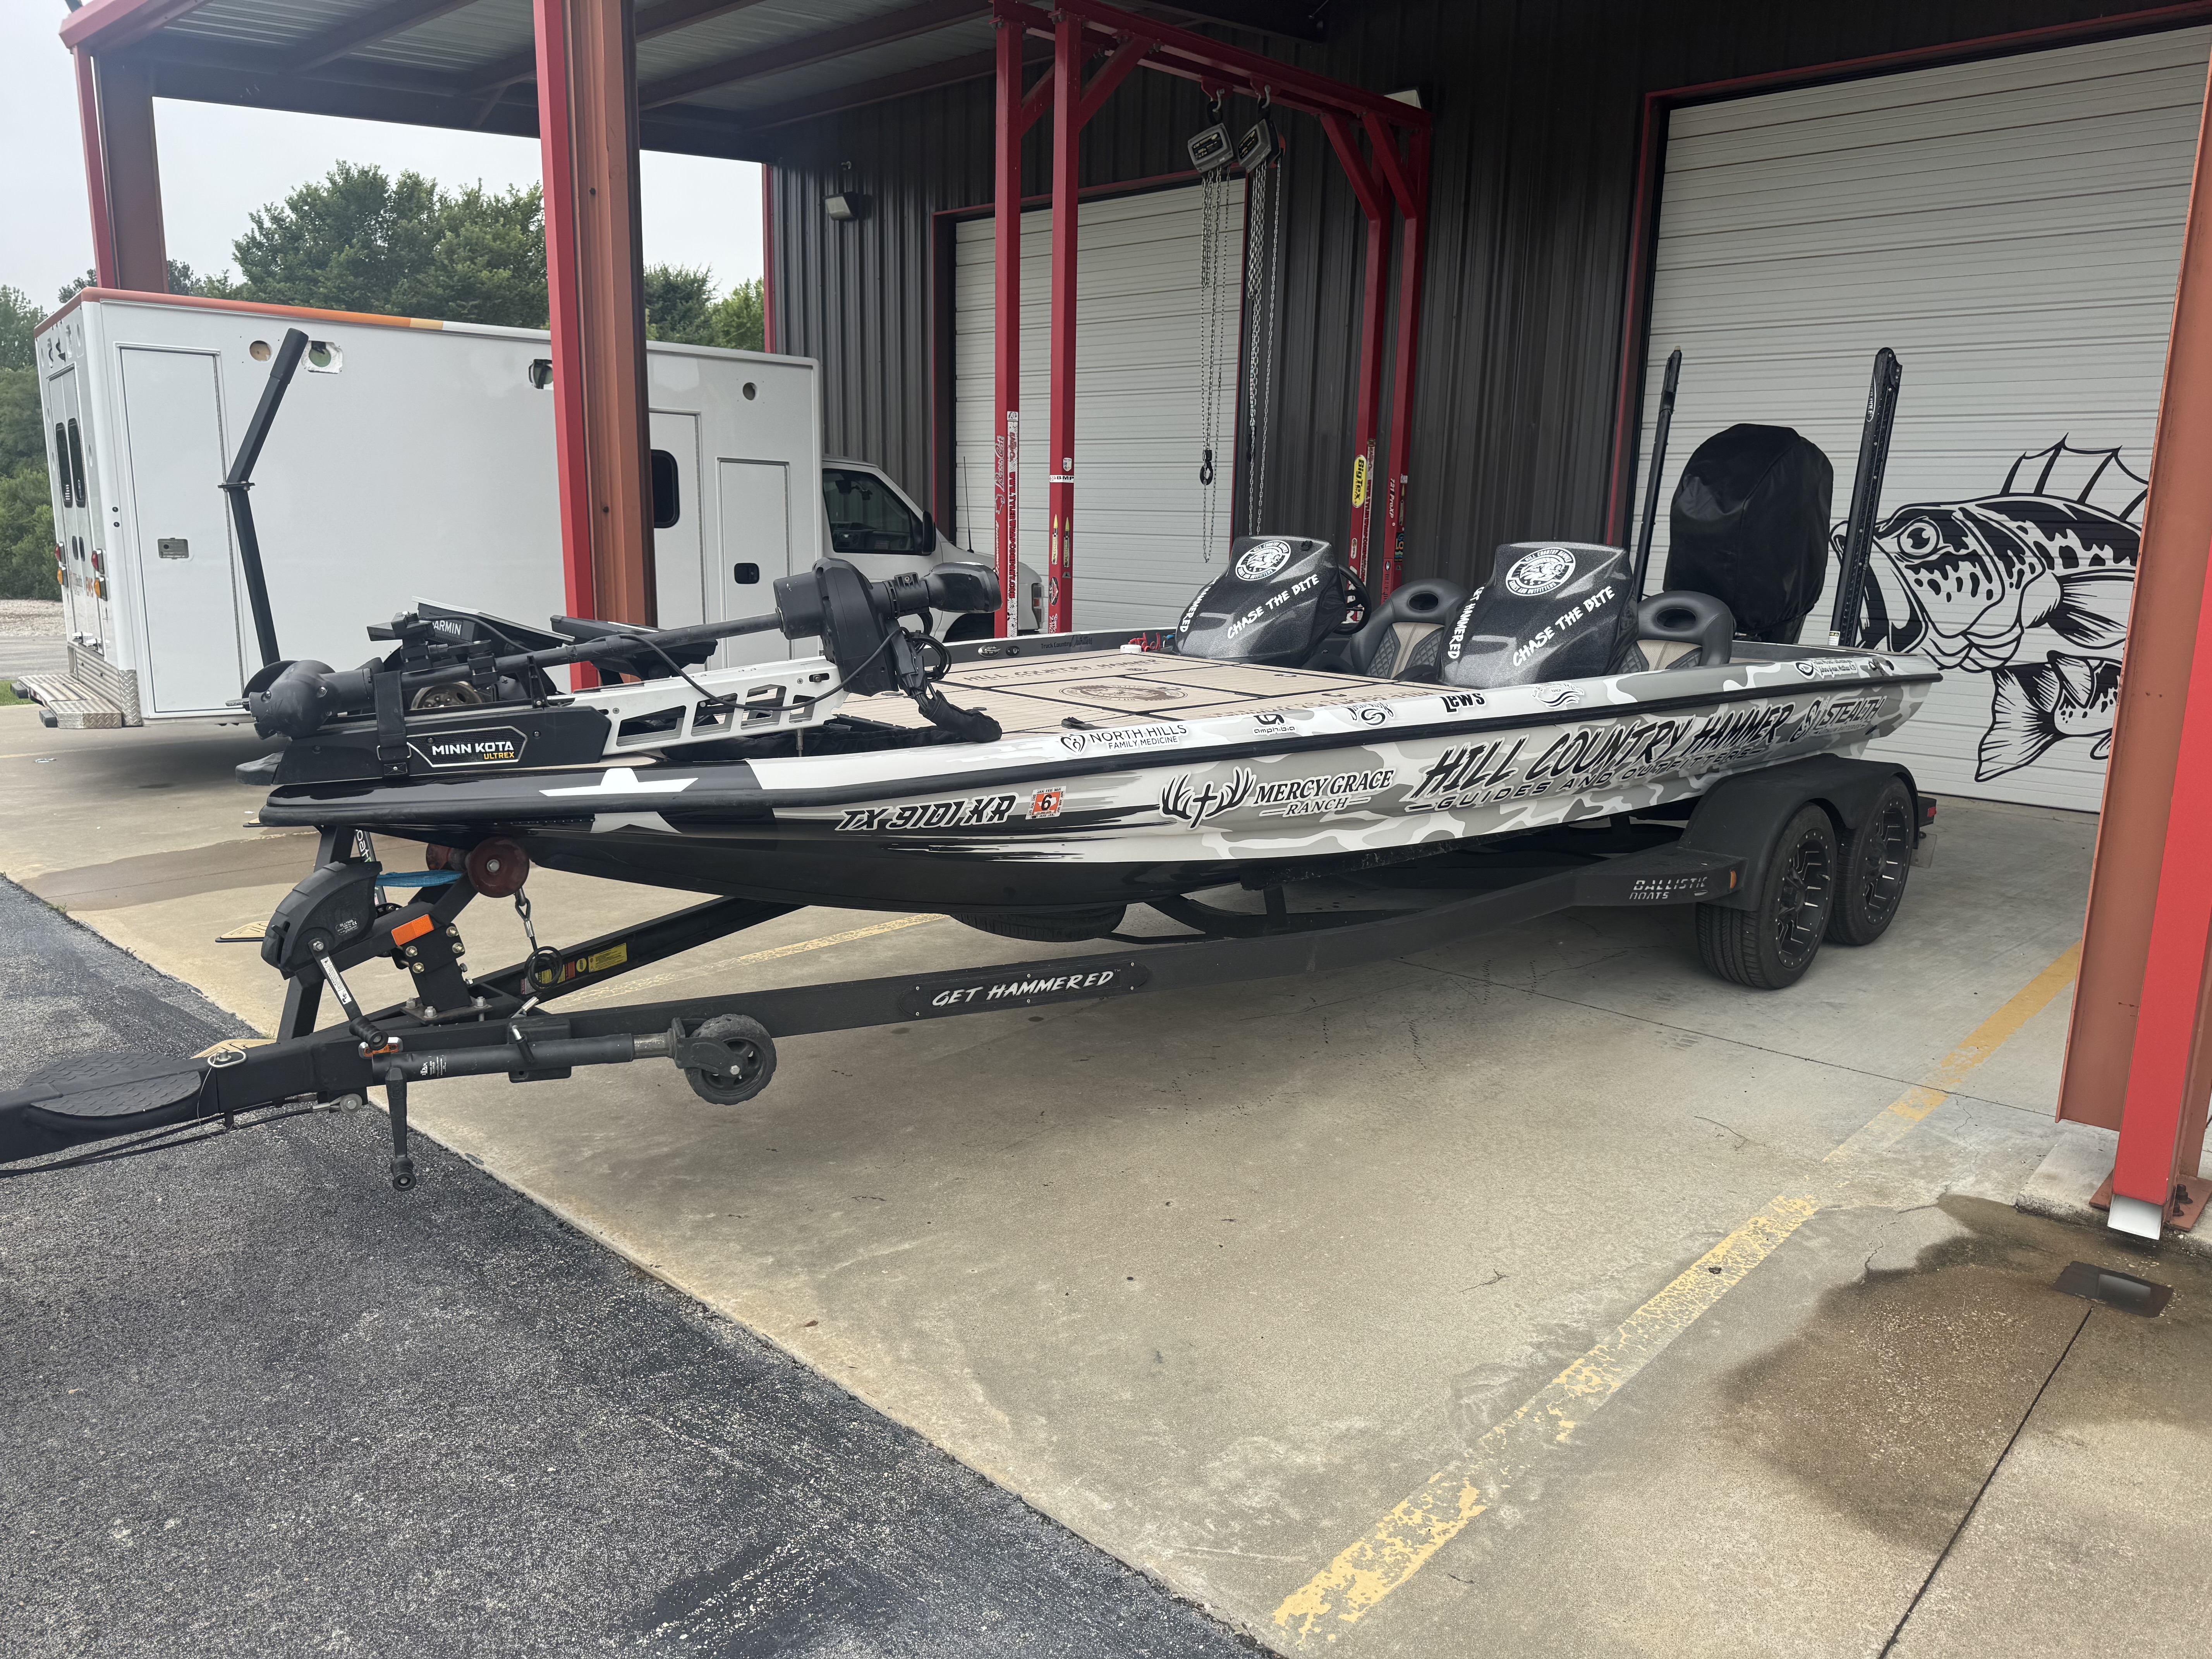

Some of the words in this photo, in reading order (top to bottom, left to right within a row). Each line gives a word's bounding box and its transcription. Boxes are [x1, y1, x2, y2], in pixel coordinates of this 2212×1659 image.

[1470, 586, 1485, 601] GET
[1180, 586, 1211, 633] HAMMERED
[1227, 606, 1264, 639] CHASE
[1265, 590, 1290, 610] THE
[1291, 574, 1320, 596] BITE
[432, 620, 462, 635] ARMIN
[1447, 603, 1476, 659] HAMMERED
[1512, 626, 1555, 667] CHASE
[1554, 606, 1583, 630] THE
[1582, 586, 1615, 613] BITE
[1818, 698, 1885, 726] STEALTH
[1089, 729, 1144, 743] NORTH
[1146, 725, 1187, 737] HILLS
[1254, 726, 1295, 734] amphibia
[432, 743, 472, 756] MINN
[475, 741, 514, 753] KOTA
[1108, 740, 1137, 749] FAMILY
[1140, 736, 1178, 746] MEDICINE
[1410, 736, 1527, 800] HILL
[1525, 714, 1695, 781] COUNTRY
[1679, 703, 1795, 758] HAMMER
[484, 752, 515, 760] ULTREX
[1253, 778, 1329, 804] MERCY
[1329, 770, 1394, 794] GRACE
[1437, 781, 1551, 809] GUIDES
[1559, 772, 1613, 792] AND
[1621, 748, 1752, 780] OUTFITTERS
[1041, 794, 1053, 811] 6
[1286, 797, 1350, 815] RANCH
[838, 808, 890, 830] TX
[888, 800, 966, 828] 9101
[1633, 877, 1707, 890] BALLISTIC
[932, 986, 984, 1007] GET
[986, 970, 1115, 1001] HAMMERED
